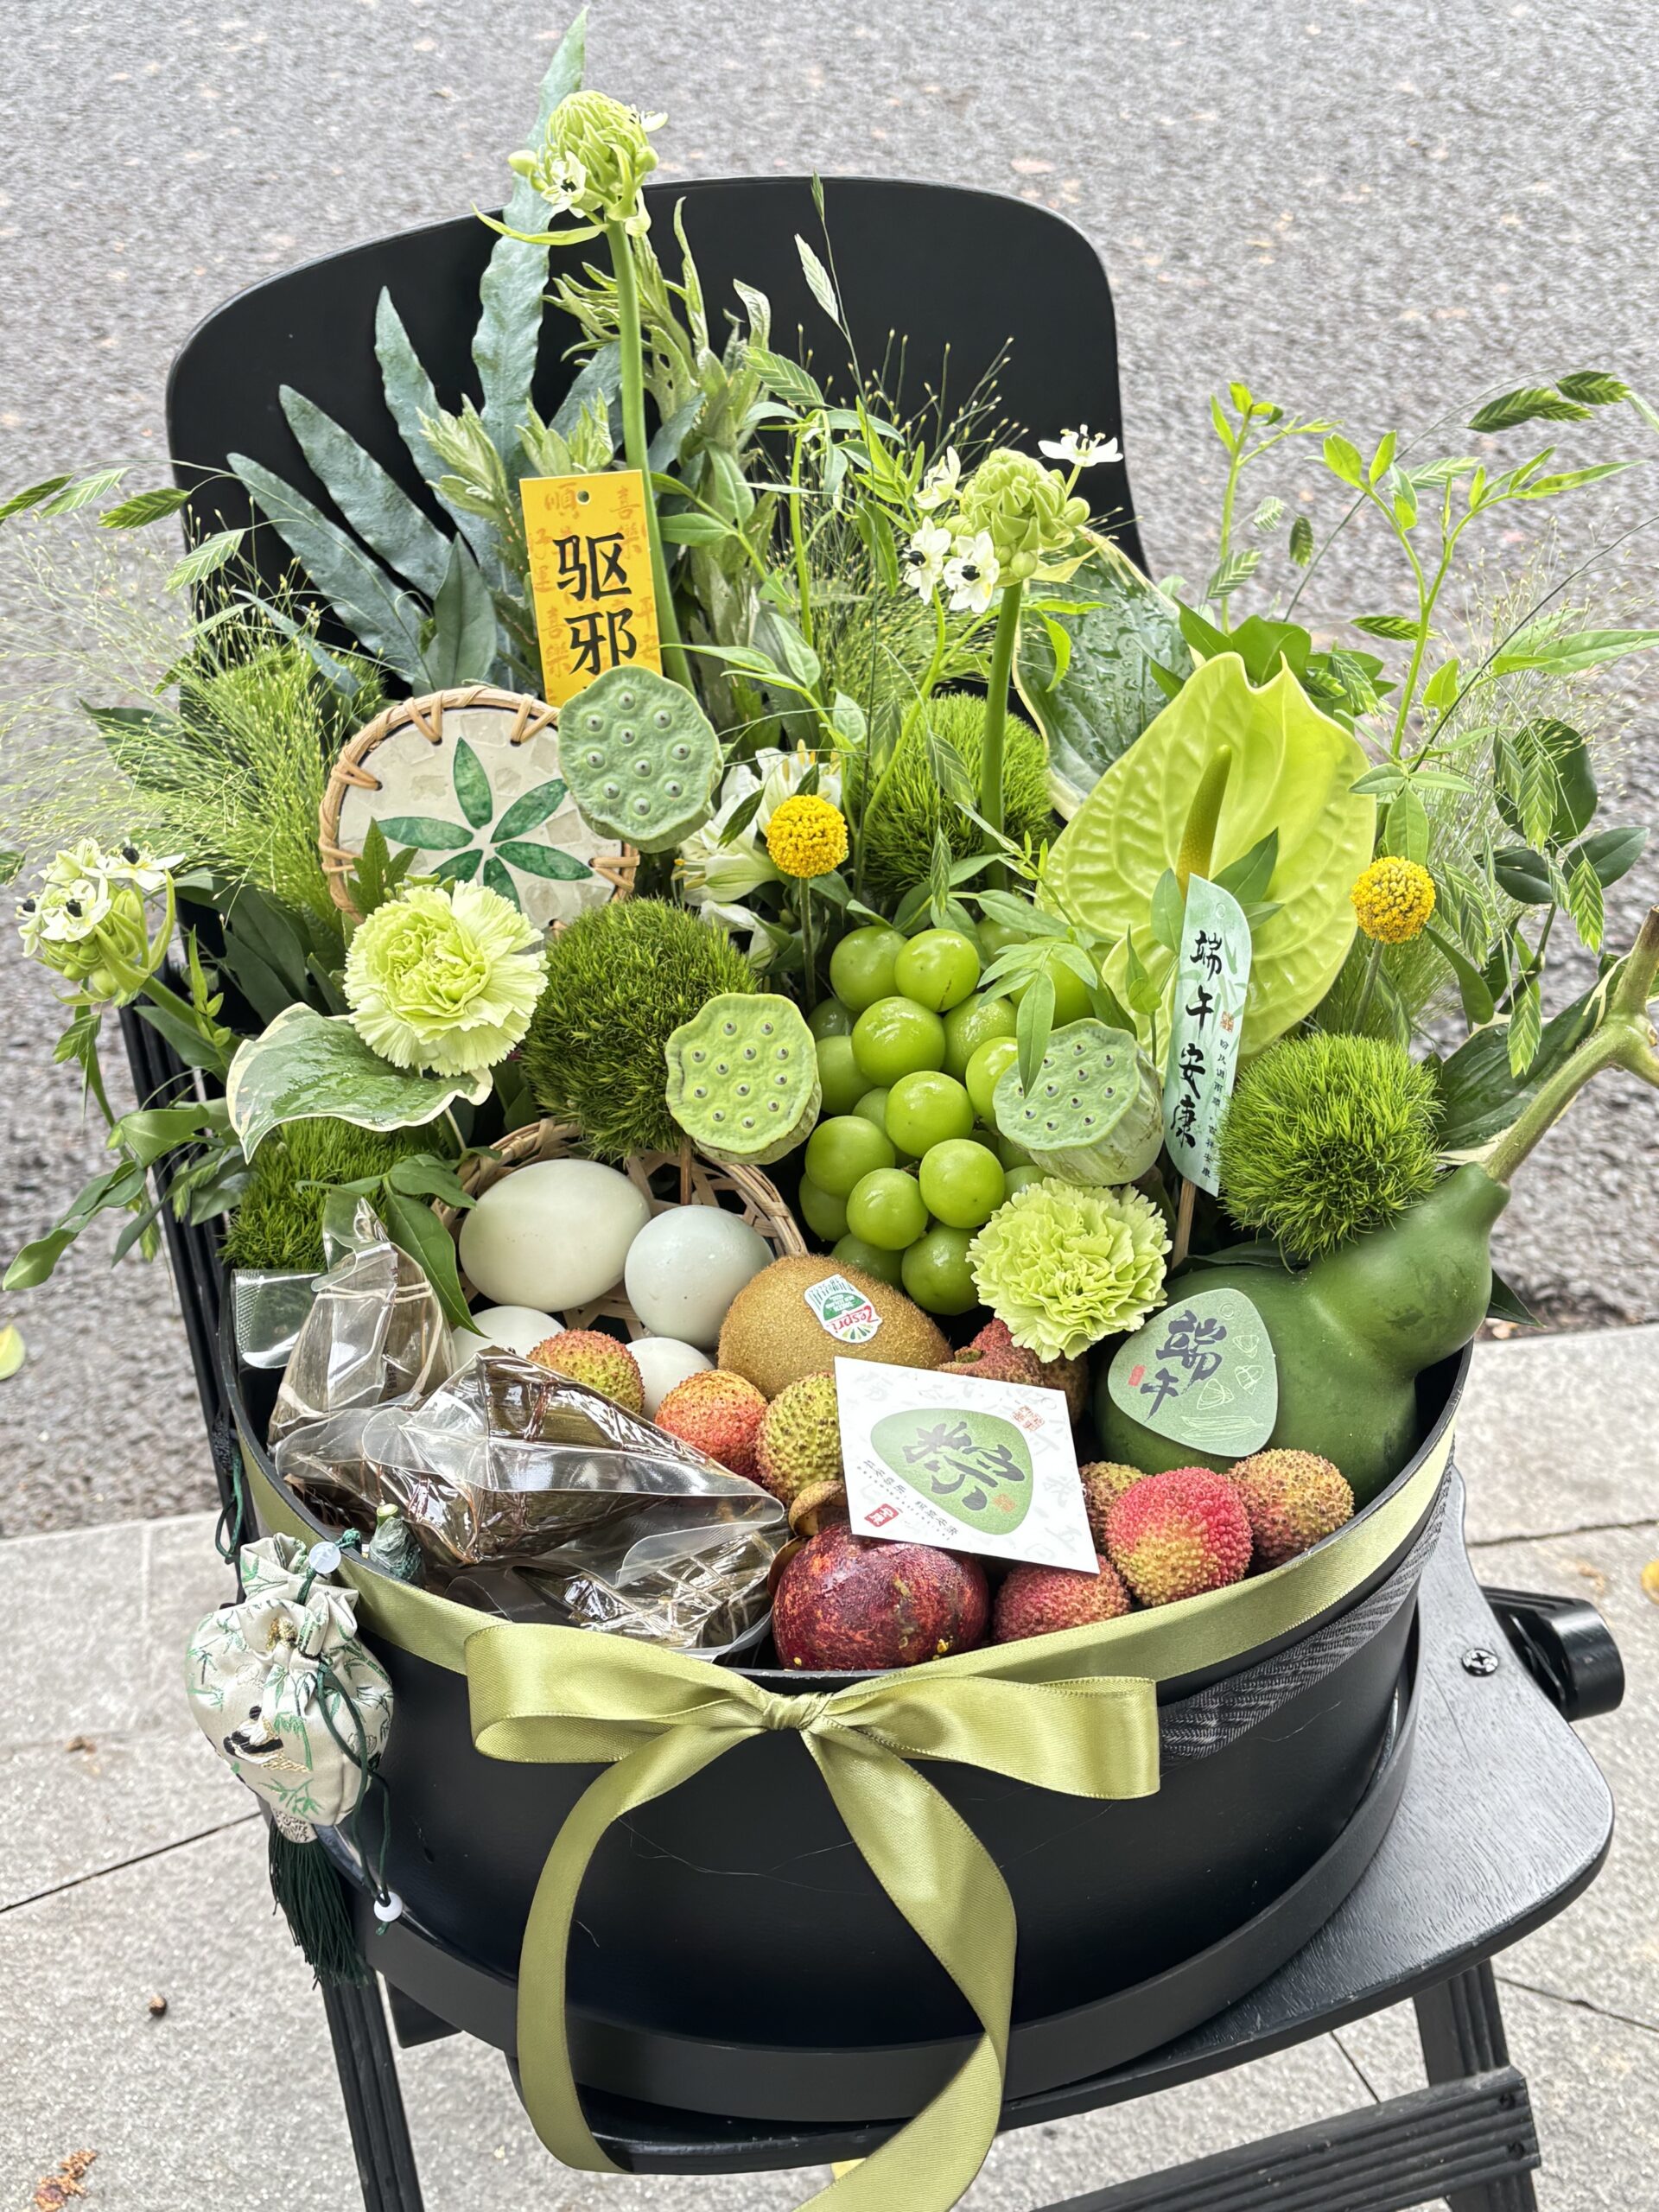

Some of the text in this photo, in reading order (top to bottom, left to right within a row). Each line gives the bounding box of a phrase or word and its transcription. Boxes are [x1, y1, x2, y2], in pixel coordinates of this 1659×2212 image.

[552, 531, 638, 676] 驱邪
[1170, 930, 1223, 1149] 端午安康
[830, 1306, 880, 1334] Zespri
[1140, 1309, 1227, 1424] 端午
[901, 1421, 1026, 1511] 粽
